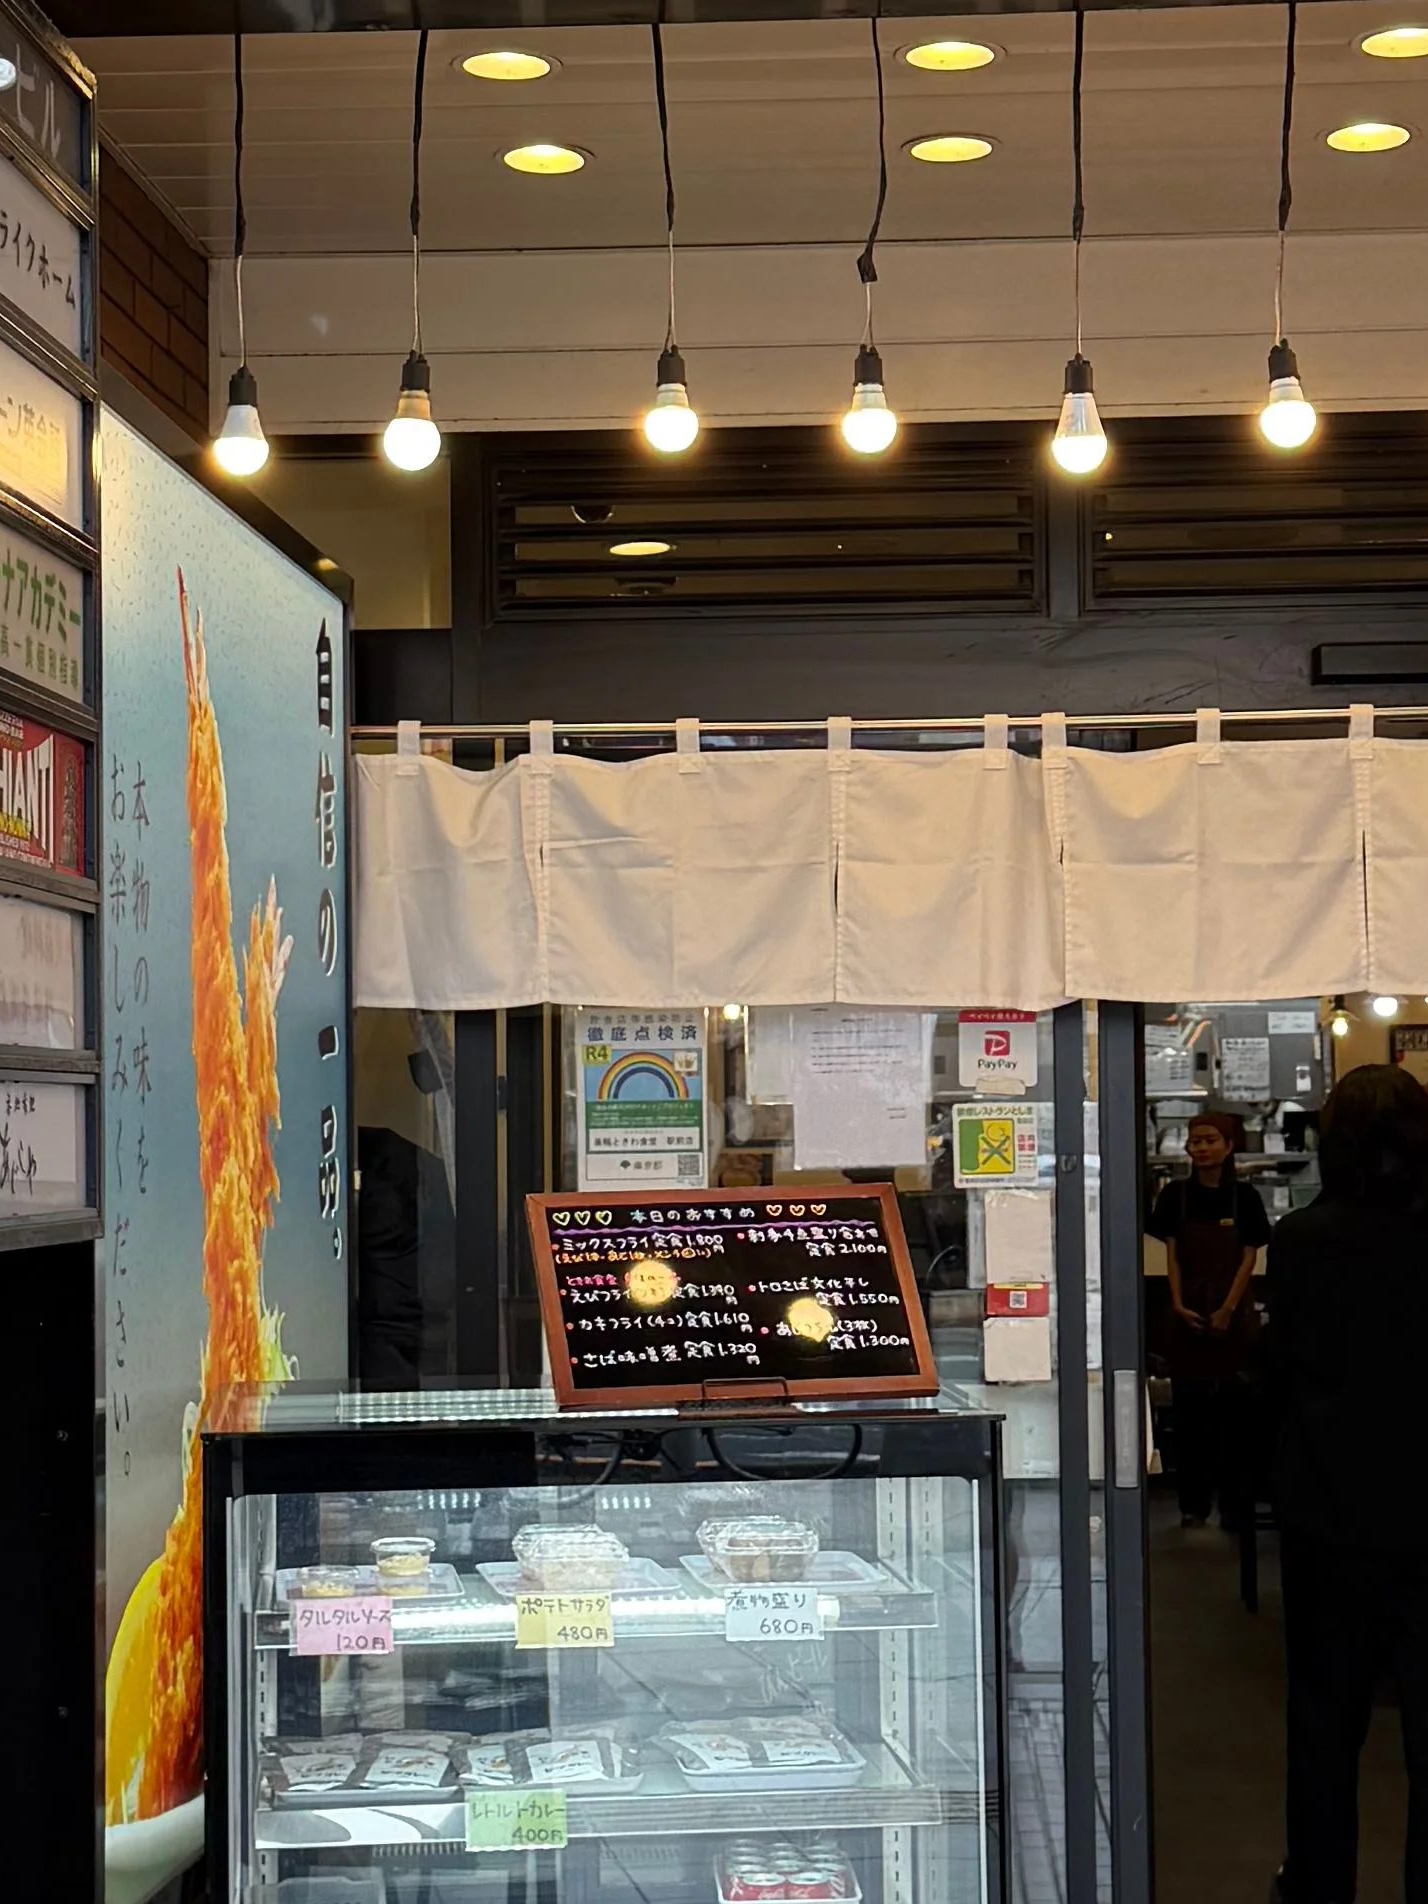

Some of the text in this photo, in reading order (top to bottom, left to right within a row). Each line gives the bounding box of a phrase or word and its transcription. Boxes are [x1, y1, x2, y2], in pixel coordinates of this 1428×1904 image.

[587, 1024, 697, 1042] 徹底点検済
[585, 1046, 609, 1061] R4
[977, 1058, 1018, 1071] PayPay
[630, 1207, 756, 1224] 本日のおすすめ
[520, 1594, 608, 1618] ポテトサラダ
[298, 1606, 393, 1628] タルタルソース
[758, 1616, 815, 1637] 680円
[555, 1622, 609, 1643] 480円
[335, 1633, 387, 1653] 120円
[471, 1798, 566, 1820] レトルトカレー
[511, 1825, 565, 1843] 400円
